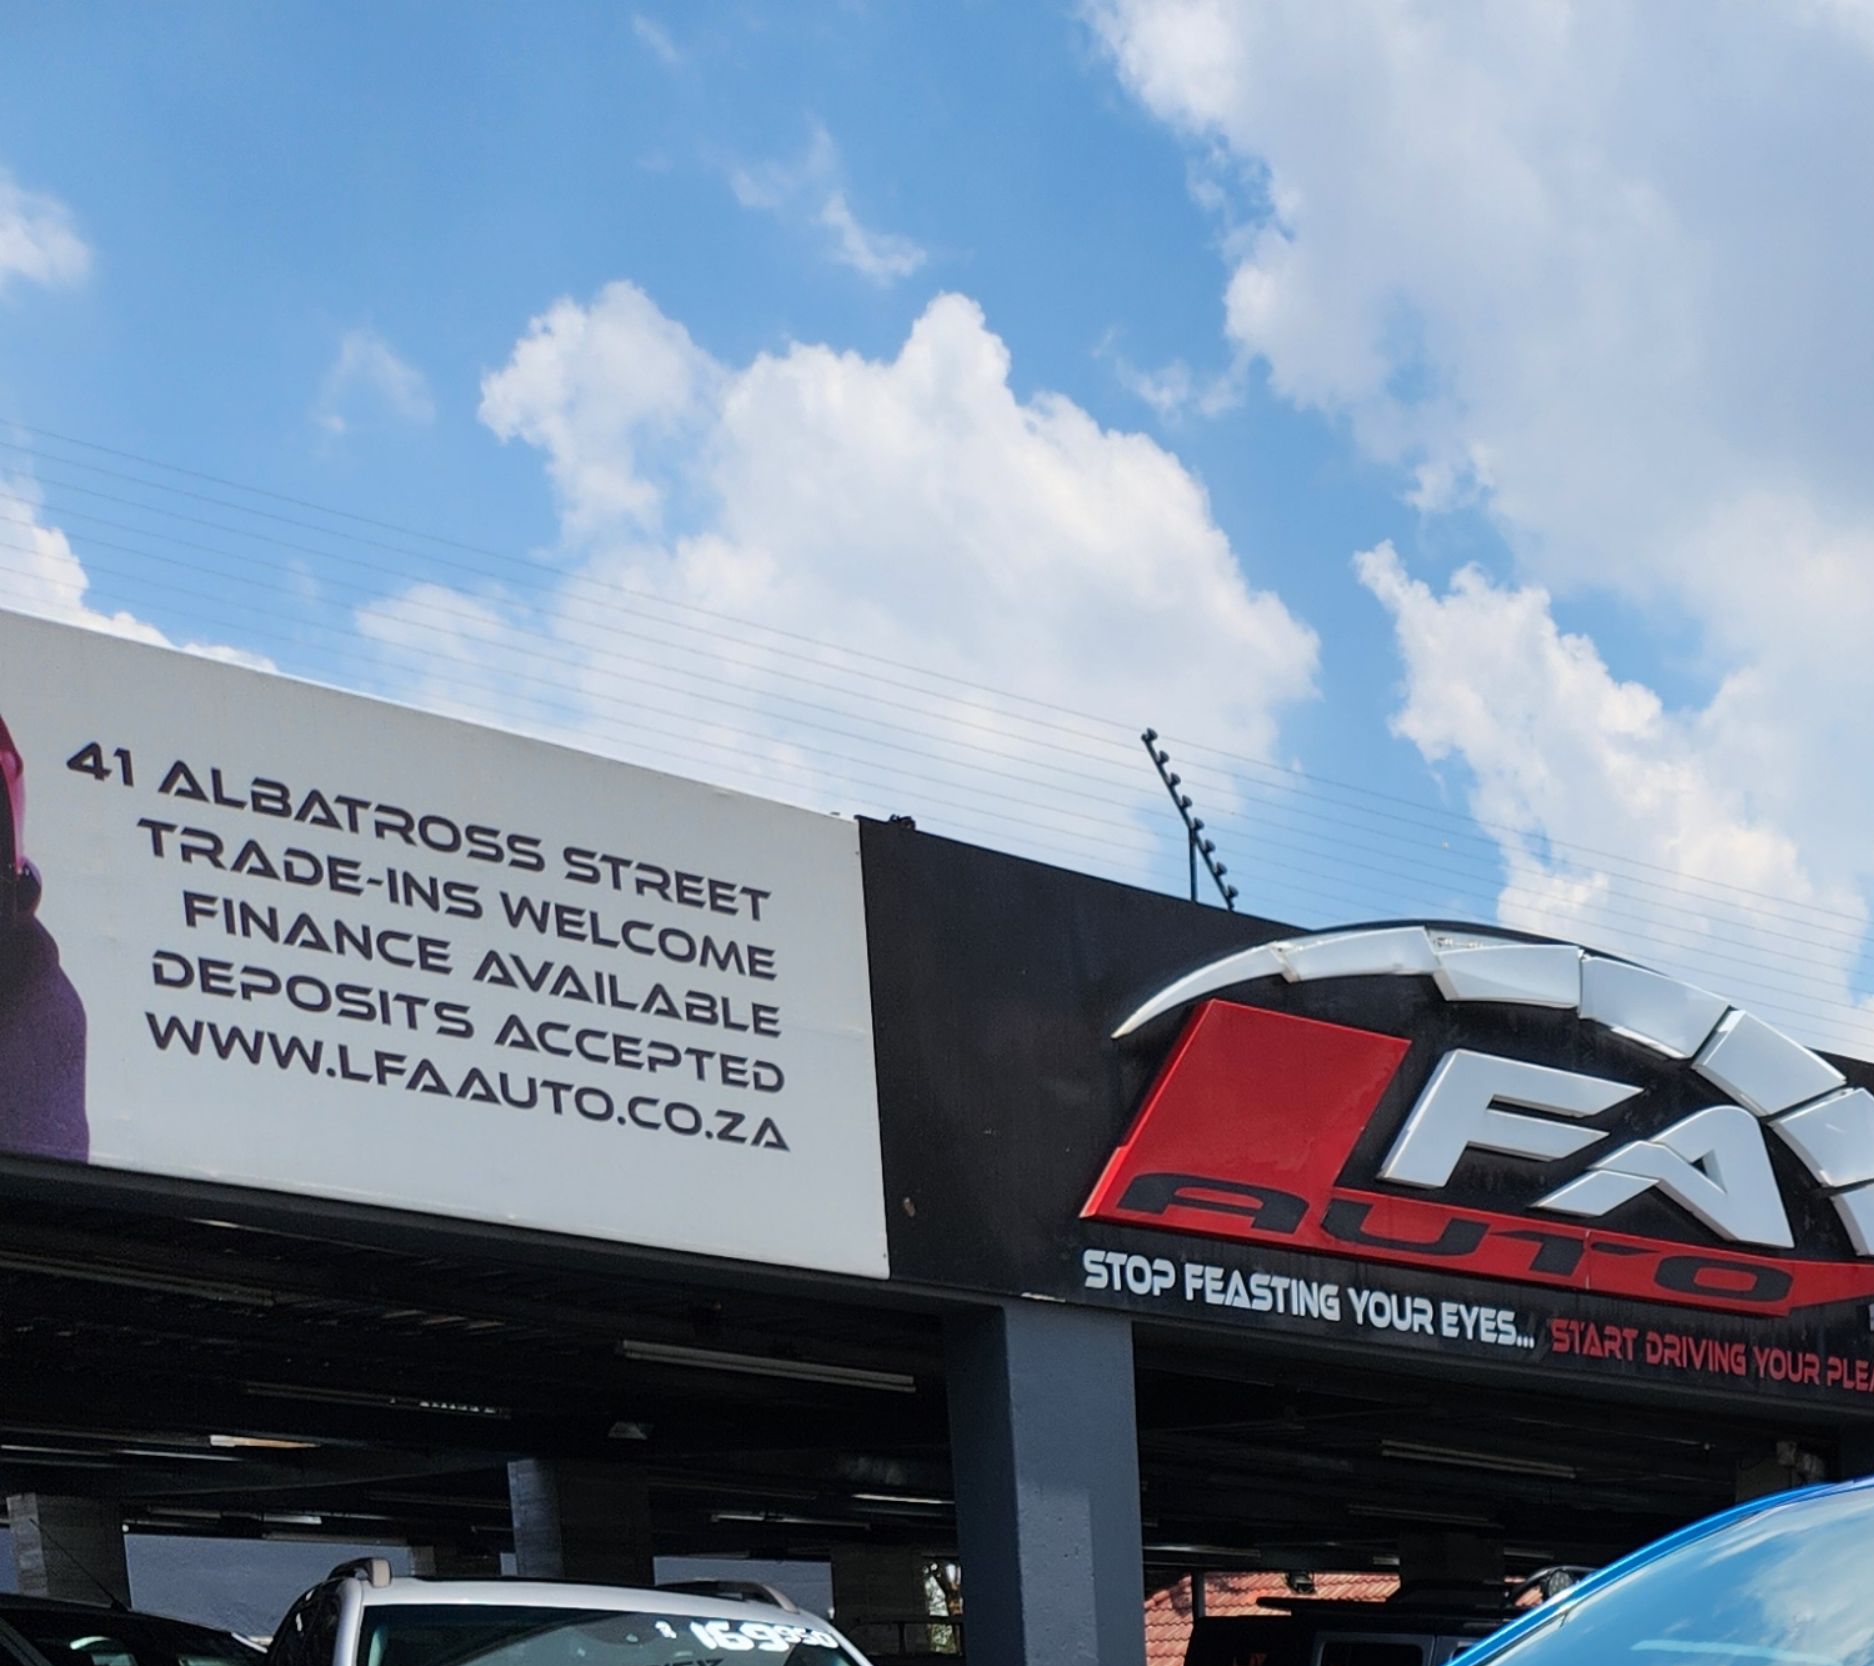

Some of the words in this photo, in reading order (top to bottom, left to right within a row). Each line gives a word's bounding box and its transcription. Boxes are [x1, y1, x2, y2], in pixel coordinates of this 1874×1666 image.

[66, 741, 134, 787] 41
[157, 759, 546, 873] ALBATROSS
[562, 846, 771, 922] STREET
[136, 817, 483, 920] TRADE-INS
[500, 890, 777, 981] WELCOME
[152, 949, 475, 1039] DEPOSITS
[494, 1013, 785, 1093] ACCEPTED
[182, 889, 453, 975] FINANCE
[472, 949, 781, 1039] AVAILABLE
[144, 1011, 790, 1151] WWW.LFAAUTO.CO.ZA
[1080, 999, 1796, 1252] LFA
[1116, 1171, 1794, 1304] AUTO
[1083, 1249, 1176, 1297] STOP
[1184, 1262, 1341, 1322] FEASTING
[1348, 1288, 1434, 1335] YOUR
[1440, 1302, 1535, 1350] EYES...
[1550, 1317, 1639, 1360] START
[1645, 1331, 1747, 1376] DRIVING
[1752, 1347, 1821, 1385] YOUR
